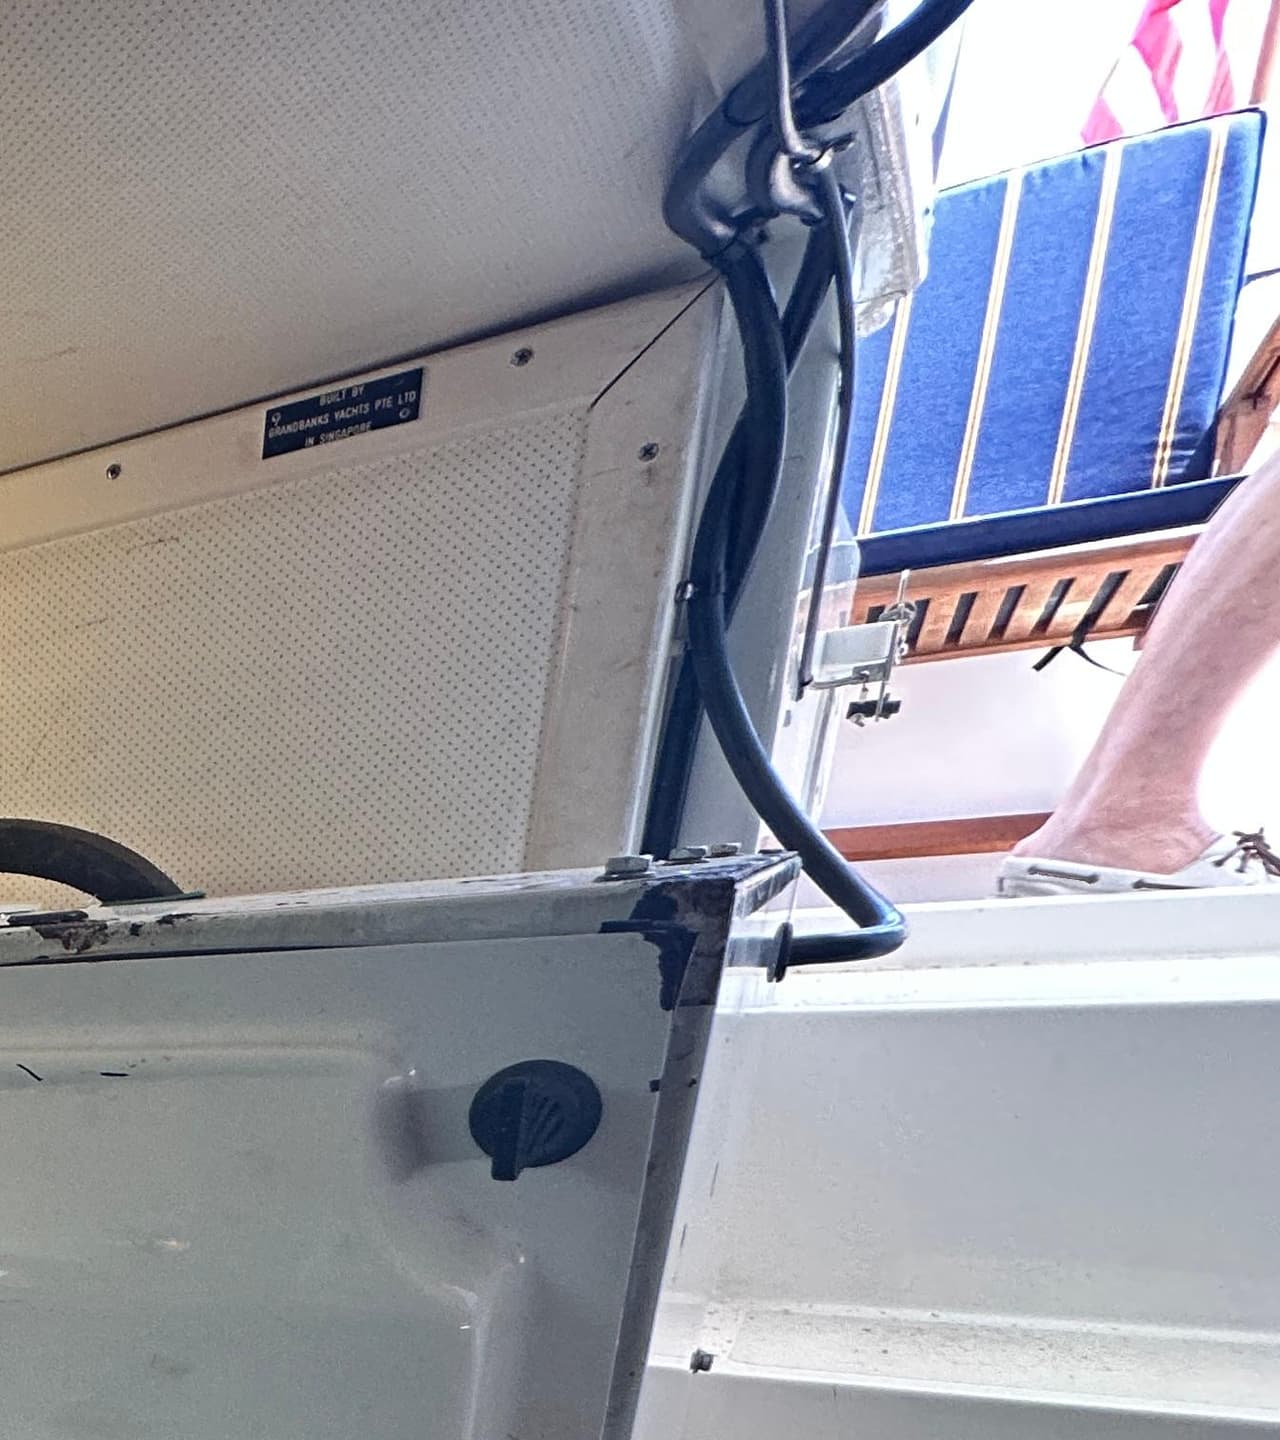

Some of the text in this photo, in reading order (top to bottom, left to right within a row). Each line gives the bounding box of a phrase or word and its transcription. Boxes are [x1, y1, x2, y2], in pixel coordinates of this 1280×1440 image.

[319, 385, 365, 406] BUILT BY
[268, 391, 417, 439] GRANDBANKS YACHTS PTE LTD
[304, 421, 372, 447] IN SINGAPORE
